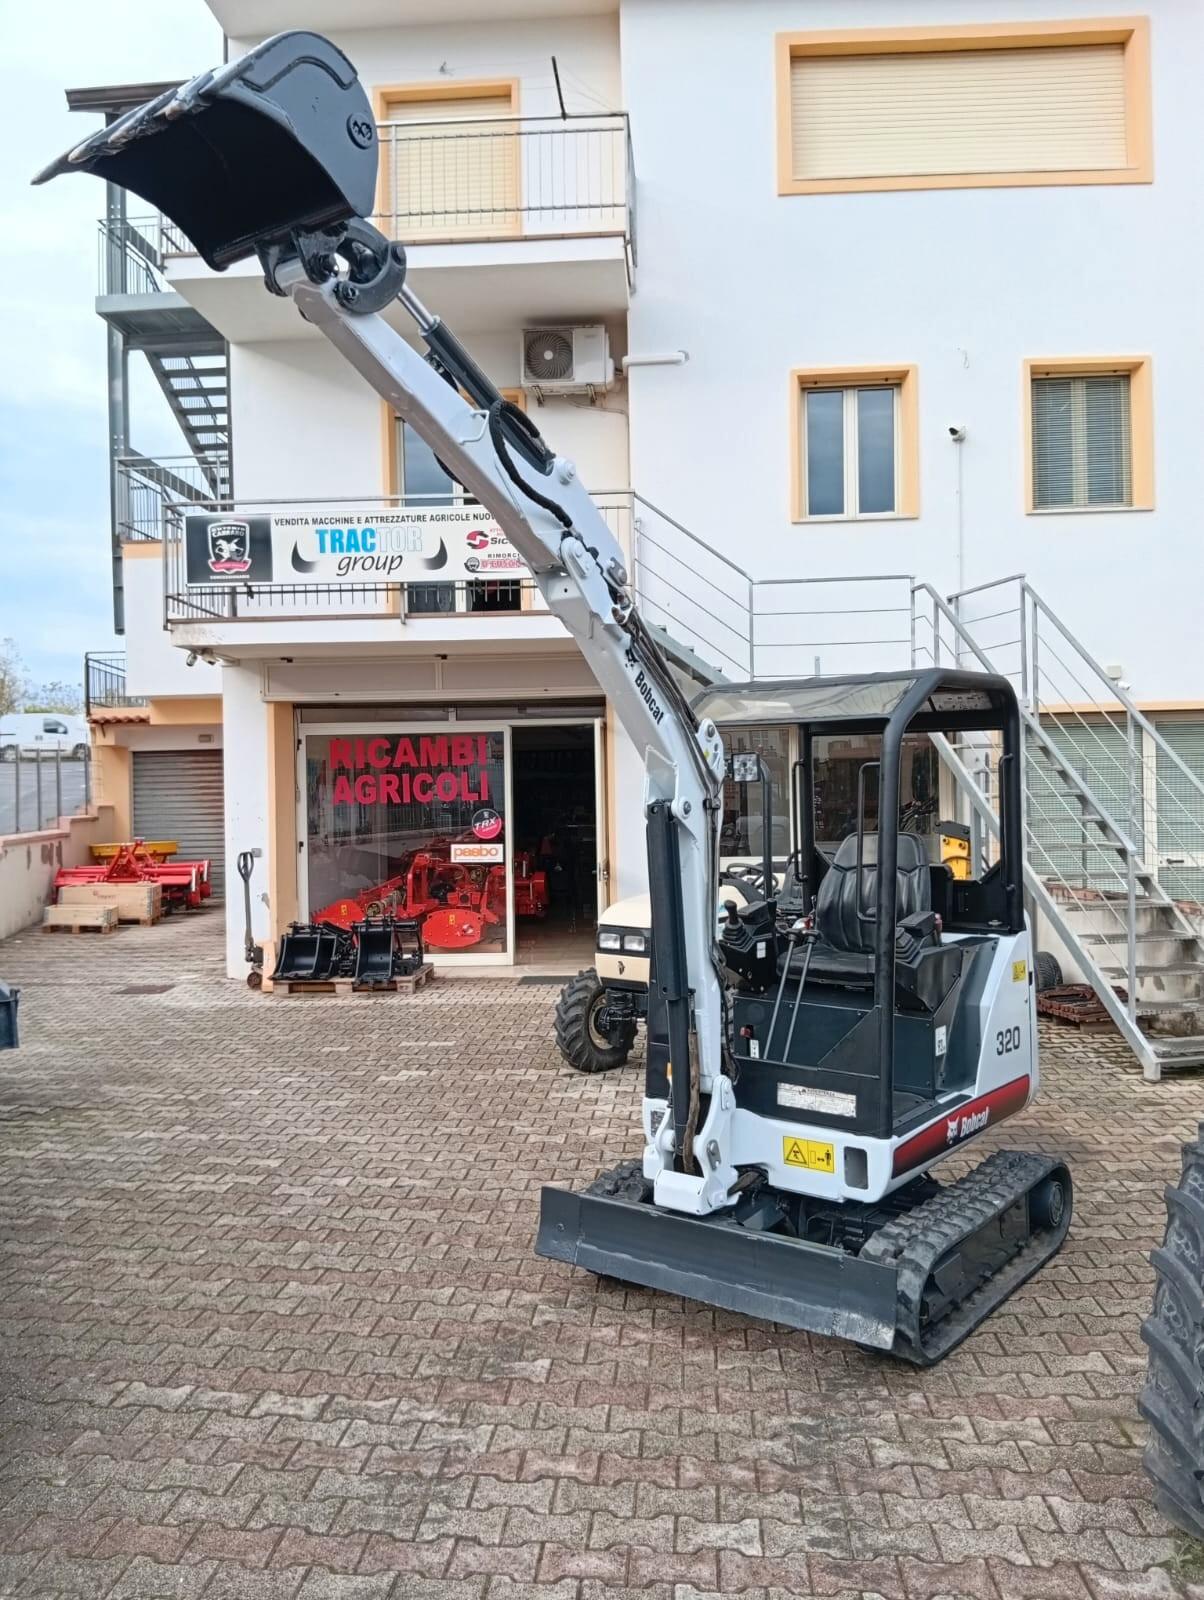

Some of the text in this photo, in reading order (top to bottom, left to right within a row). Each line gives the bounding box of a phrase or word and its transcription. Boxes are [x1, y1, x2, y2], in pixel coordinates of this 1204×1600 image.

[274, 518, 310, 526] VENDITA
[311, 516, 355, 525] MACCHINE
[357, 516, 362, 524] E
[364, 514, 427, 524] ATTREZZATURE
[429, 513, 471, 522] AGRICOLE
[315, 526, 423, 554] TRACTOR
[490, 537, 509, 545] SIC
[336, 554, 403, 577] group
[634, 670, 665, 725] Bobcat
[328, 735, 488, 769] RICAMBI
[333, 771, 489, 806] AGRICOLI
[474, 816, 497, 831] TRX
[996, 1025, 1020, 1056] 320
[960, 1105, 990, 1138] Bobcat
